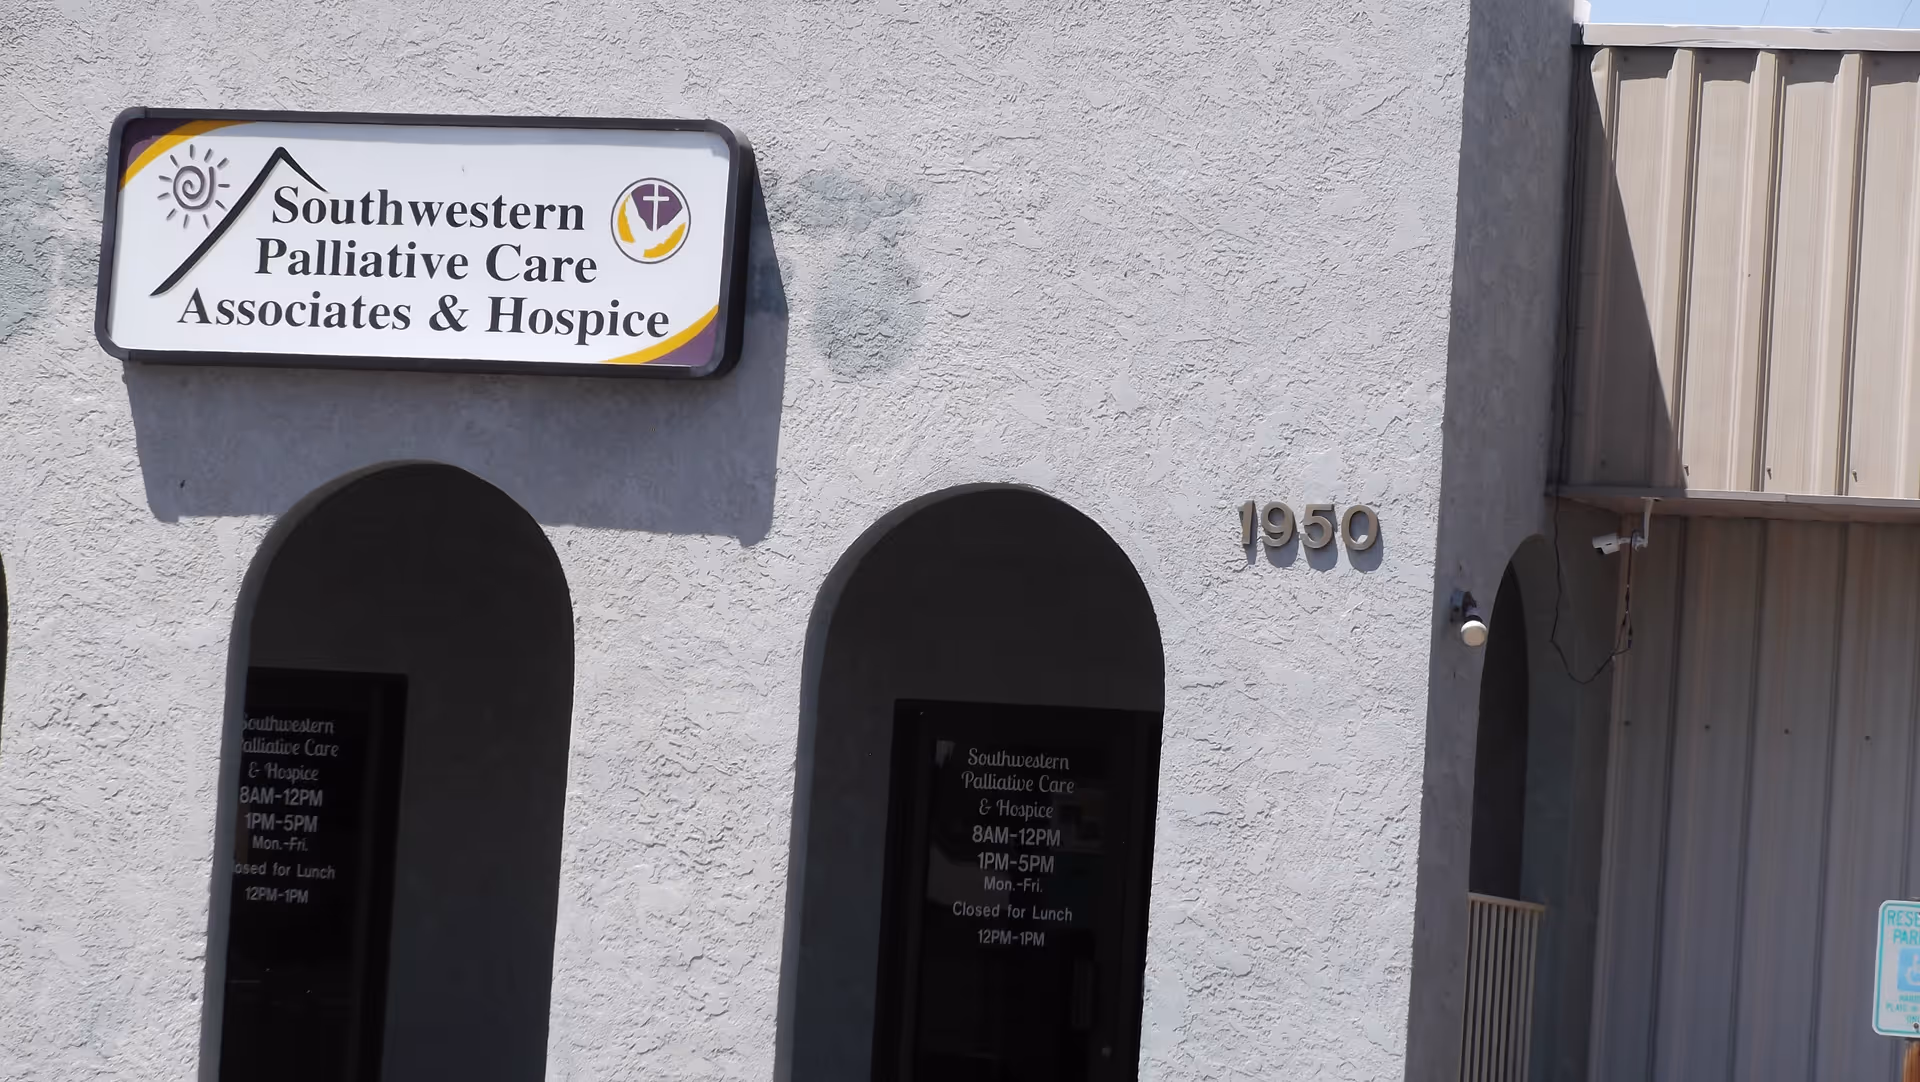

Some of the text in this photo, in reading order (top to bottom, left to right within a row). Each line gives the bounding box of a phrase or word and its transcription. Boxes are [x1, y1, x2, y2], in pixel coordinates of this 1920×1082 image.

[271, 184, 585, 231] Southwestern
[254, 236, 598, 284] Palliative Care
[177, 287, 670, 346] Associates & Hospice
[1238, 500, 1379, 551] 1950
[242, 737, 340, 757] alliative Care
[967, 747, 1070, 770] Southwestern
[248, 761, 319, 784] & Hospice
[961, 771, 1075, 793] Palliative Care
[239, 786, 324, 807] 8AM-12PM
[979, 798, 1054, 822] & Hospice
[244, 812, 318, 833] 1PM-5PM
[252, 835, 309, 852] Mon.-Fri.
[972, 825, 1061, 846] 8AM-12PM
[233, 862, 336, 880] osed for Lunch
[977, 852, 1055, 873] 1PM-5PM
[984, 875, 1043, 893] Mon.-Fri.
[244, 886, 309, 904] 12PM-1PM
[952, 900, 1073, 922] Closed for Lunch
[977, 929, 1045, 947] 12PM-1PM
